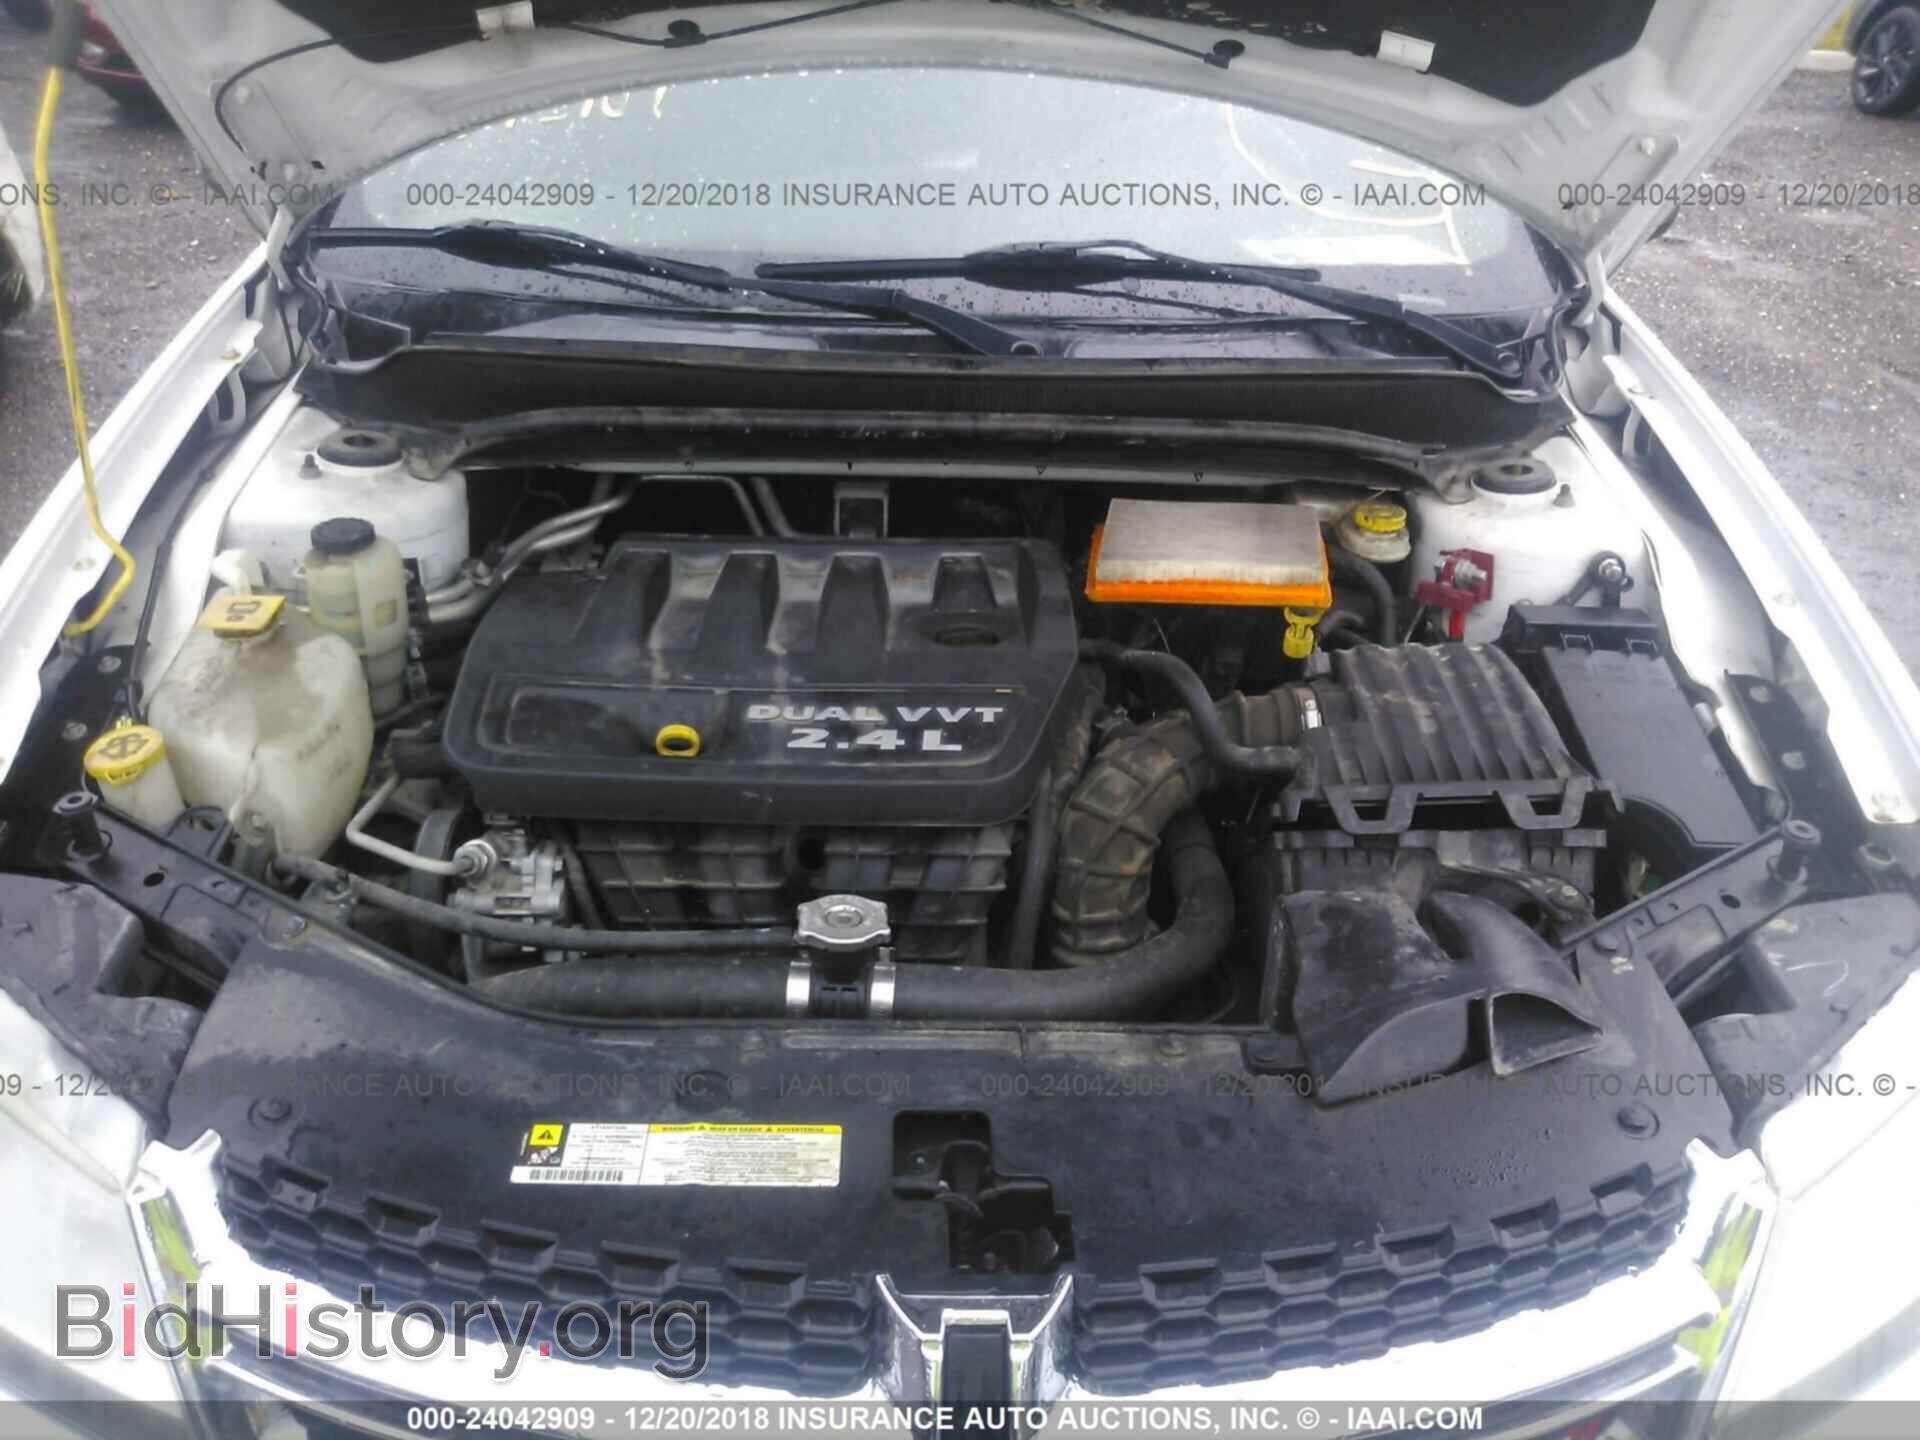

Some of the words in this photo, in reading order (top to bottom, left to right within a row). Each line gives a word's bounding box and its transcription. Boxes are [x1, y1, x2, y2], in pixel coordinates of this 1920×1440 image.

[745, 704, 887, 722] DUAL
[896, 706, 1004, 723] VVT
[786, 728, 906, 751] 2.4
[921, 729, 963, 752] L
